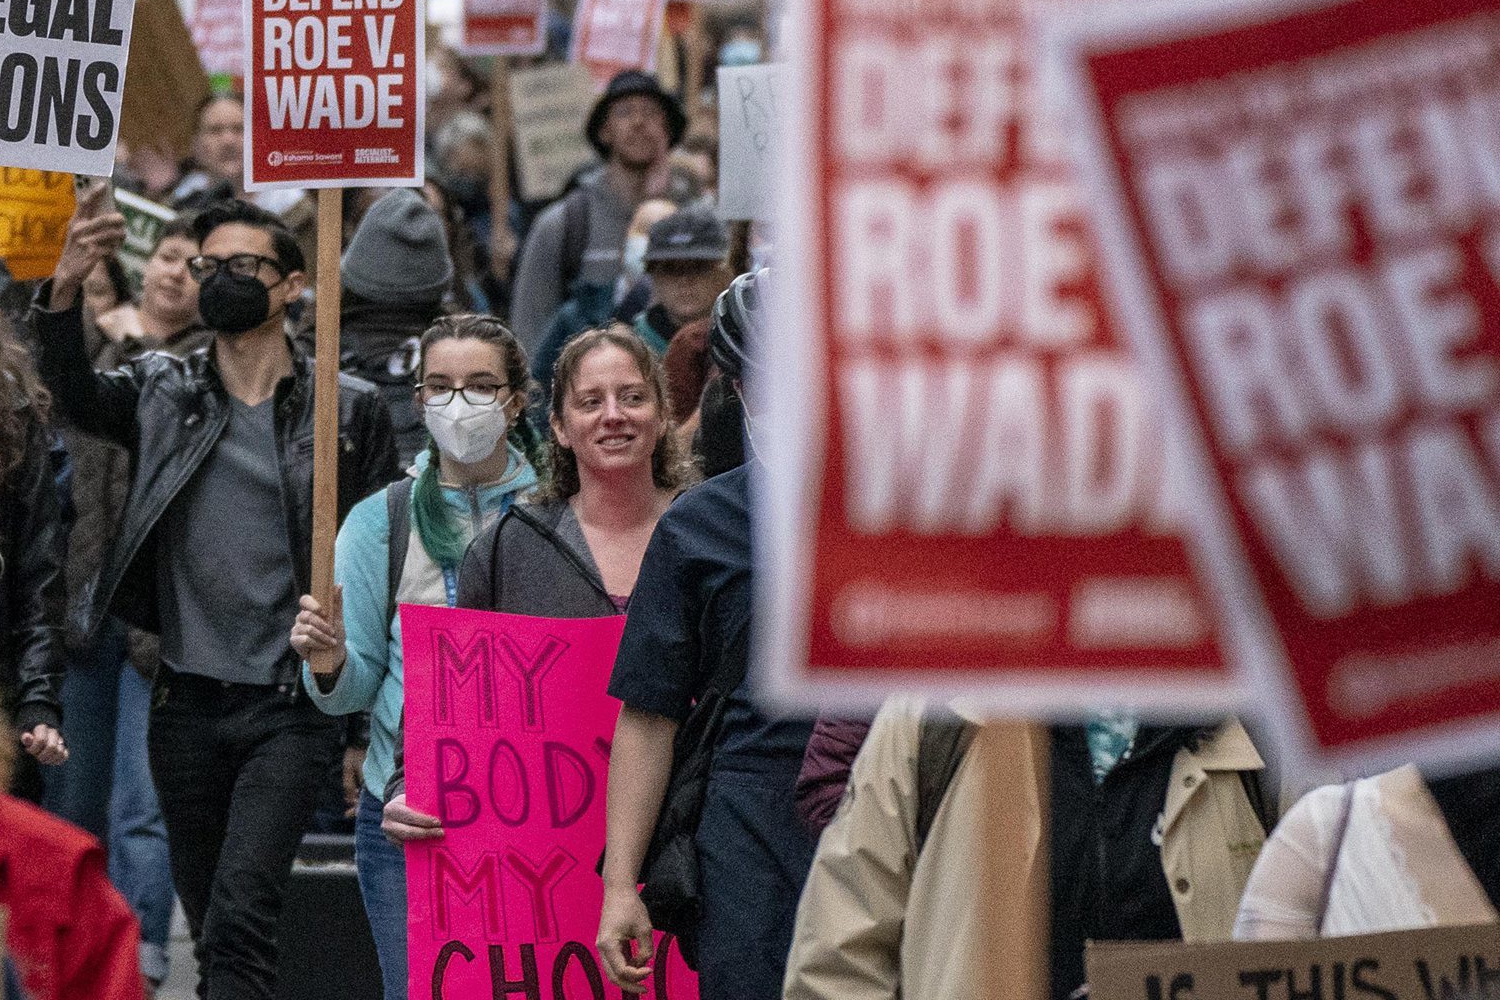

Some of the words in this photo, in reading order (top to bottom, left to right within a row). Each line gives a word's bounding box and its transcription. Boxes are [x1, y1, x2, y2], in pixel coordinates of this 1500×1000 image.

[263, 15, 352, 70] ROE
[361, 14, 405, 69] V.
[263, 74, 405, 130] WADE
[839, 180, 1098, 345] ROE
[431, 628, 571, 732] MY
[435, 737, 613, 829] BOD
[427, 845, 578, 945] MY
